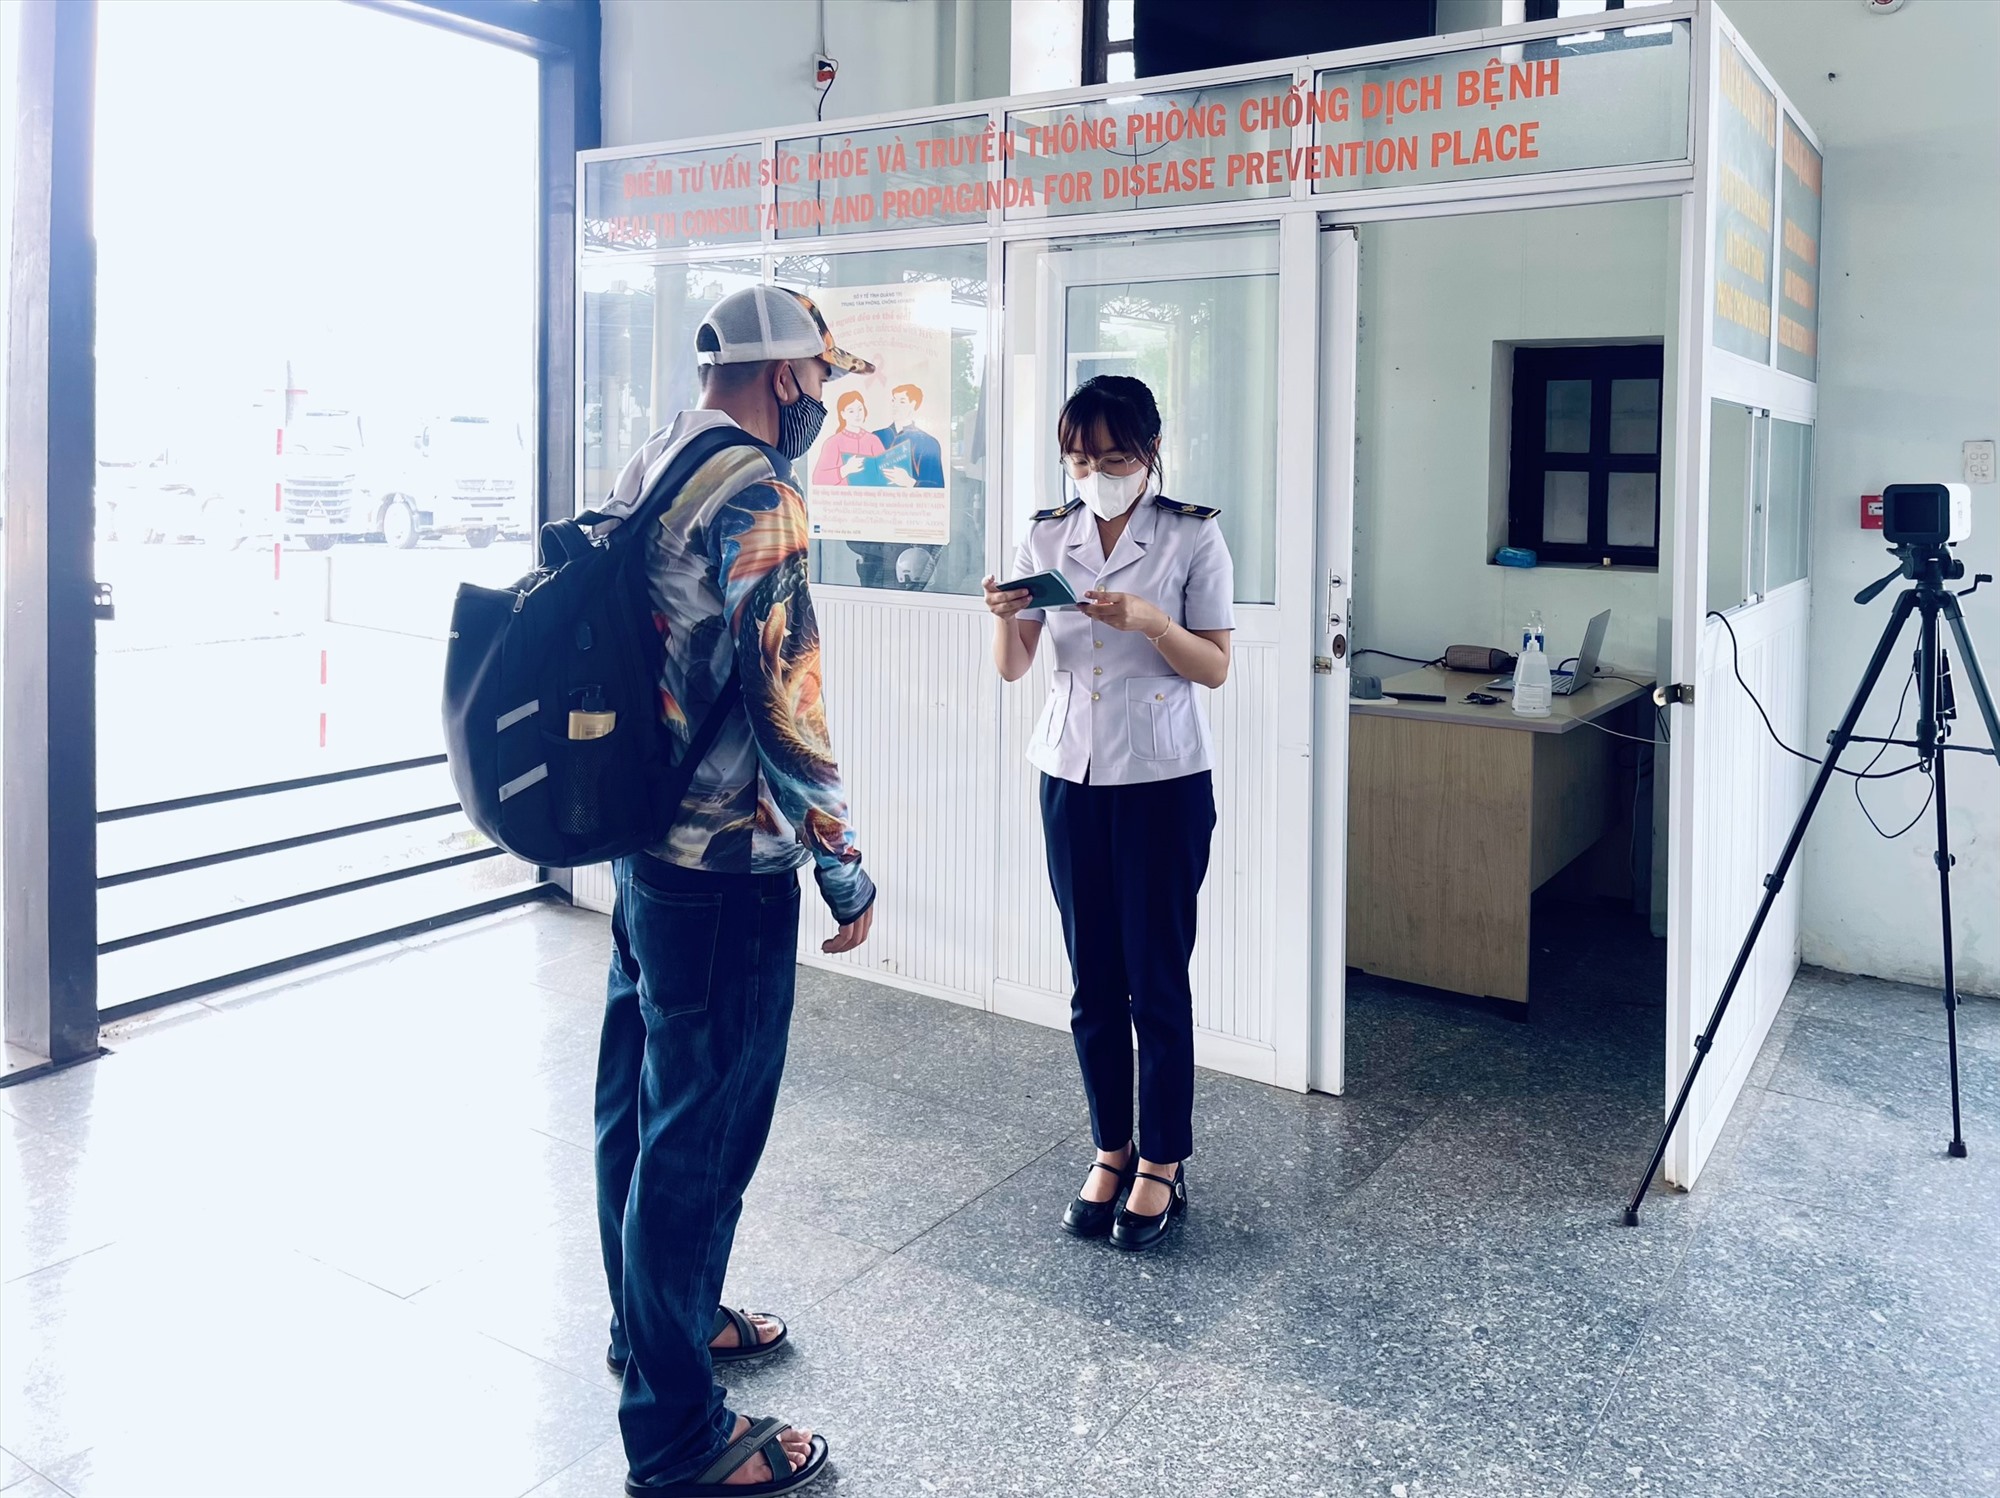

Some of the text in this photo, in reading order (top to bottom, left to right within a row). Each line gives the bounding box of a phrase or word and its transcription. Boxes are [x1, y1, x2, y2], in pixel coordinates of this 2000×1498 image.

[607, 121, 1540, 243] HEALTH CONSULTATION AND PROPAGANDA FOR DISEASE PREVENTION PLACE
[678, 160, 707, 193] TƯ
[710, 153, 751, 190] VẤN
[758, 150, 799, 187] SỨC
[808, 138, 869, 181] KHỎE
[877, 136, 907, 174] VÀ
[916, 121, 1015, 169] TRUYỀN
[1025, 114, 1117, 157] THÔNG
[1127, 101, 1226, 146] PHÒNG
[1239, 79, 1349, 132] CHỐNG
[1361, 74, 1442, 125] DỊCH
[1457, 58, 1560, 111] BỆNH
